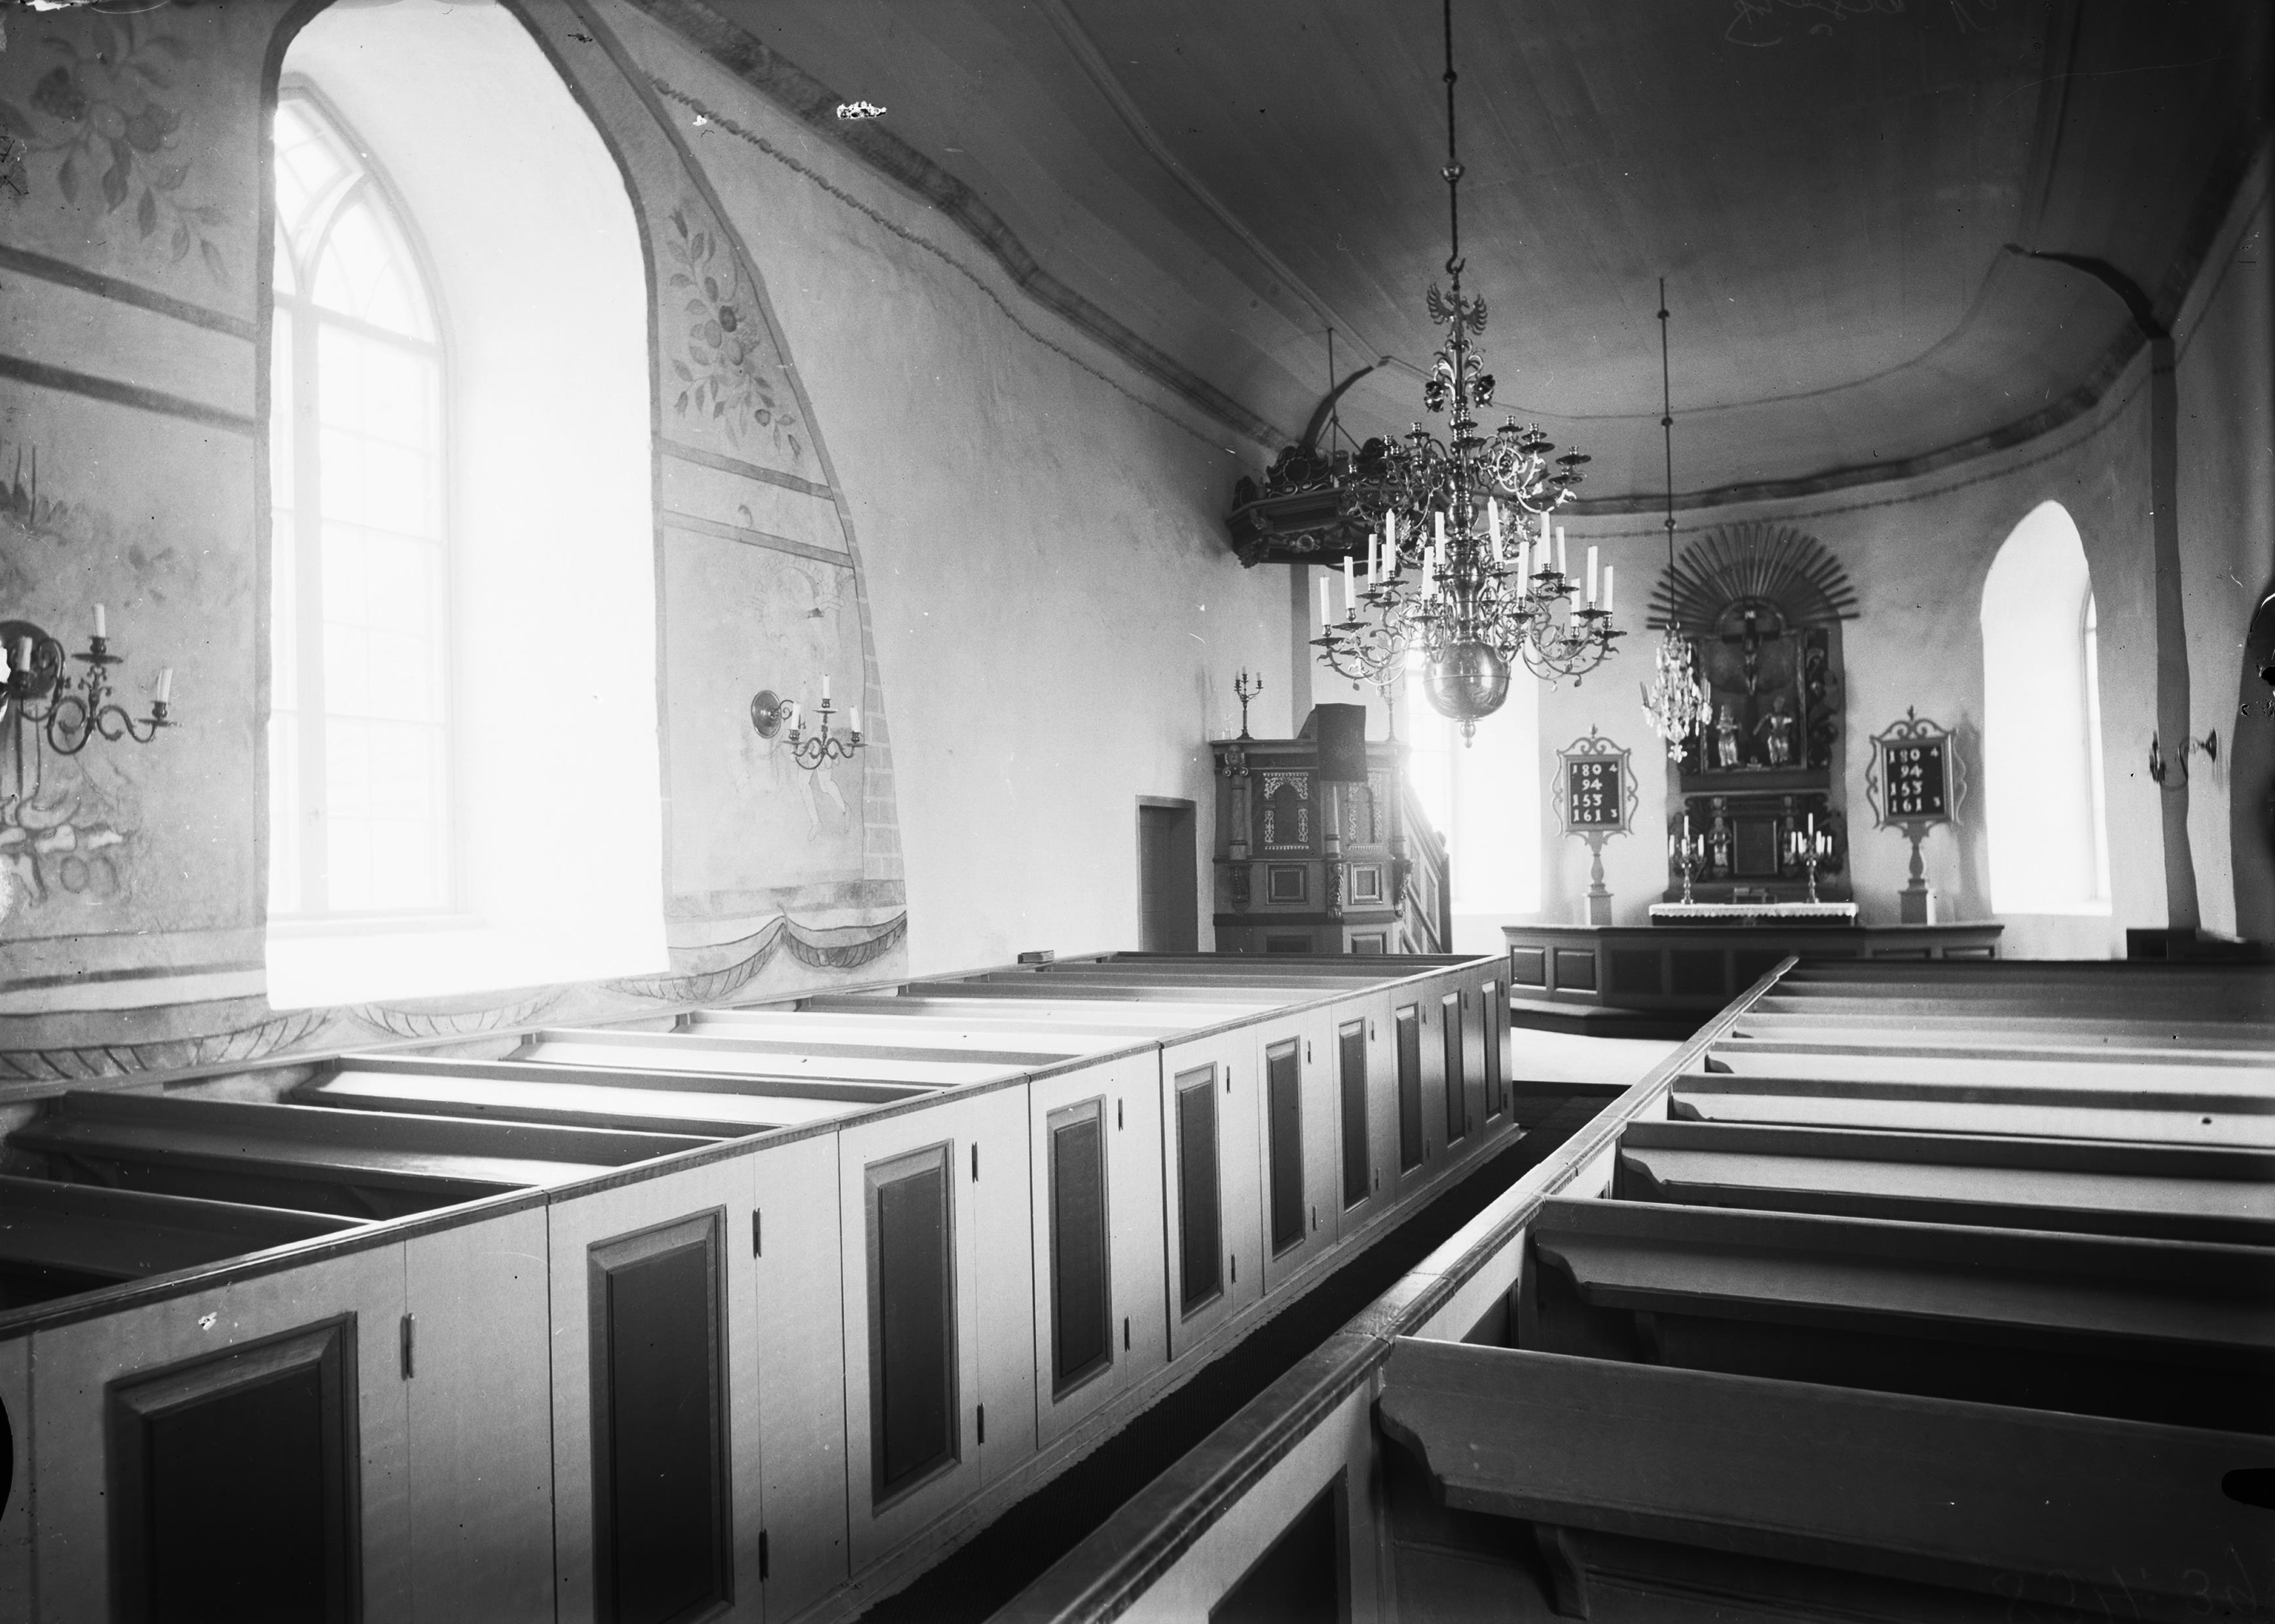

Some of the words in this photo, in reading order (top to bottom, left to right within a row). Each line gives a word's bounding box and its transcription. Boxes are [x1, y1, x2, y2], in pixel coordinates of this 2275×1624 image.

[1889, 748, 1921, 764] 180
[1572, 764, 1602, 777] 180
[1608, 763, 1618, 773] 4
[1900, 764, 1923, 778] 94
[1581, 777, 1602, 791] 94
[1890, 781, 1923, 797] 153
[1572, 794, 1602, 807] 153
[1891, 798, 1923, 813] 161
[1933, 796, 1940, 807] 3
[1573, 809, 1602, 822] 161
[1610, 809, 1618, 818] 3
